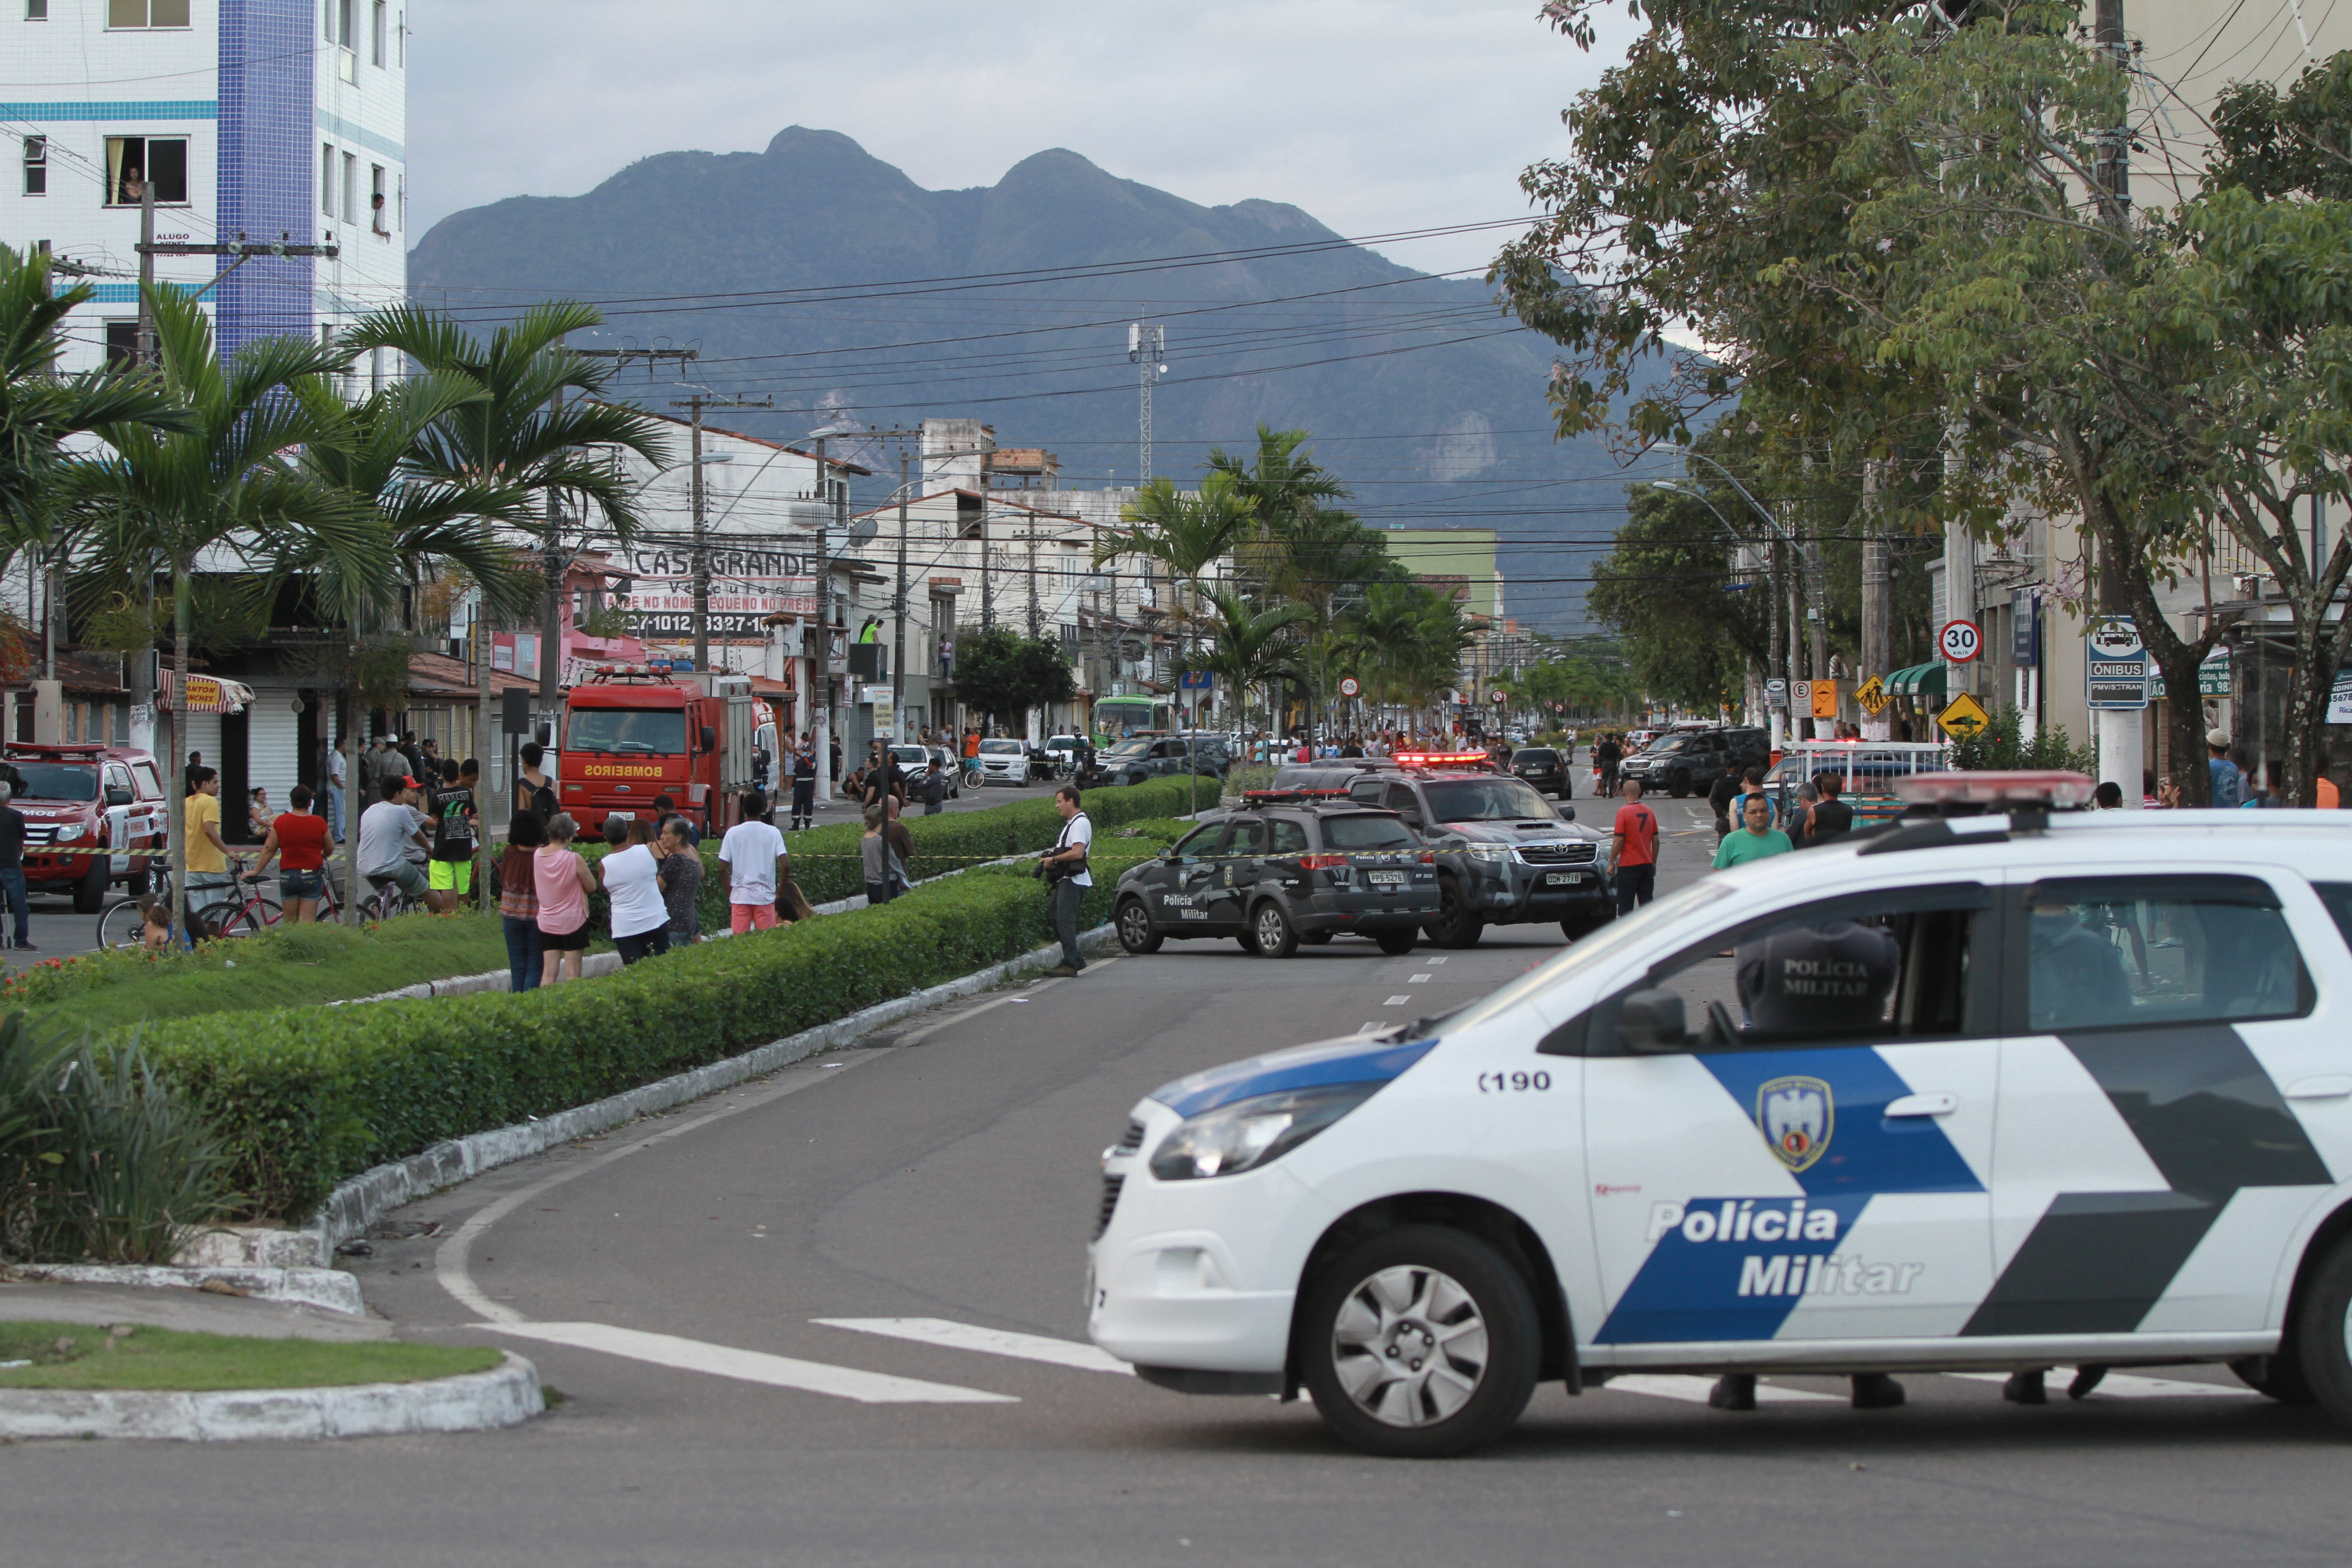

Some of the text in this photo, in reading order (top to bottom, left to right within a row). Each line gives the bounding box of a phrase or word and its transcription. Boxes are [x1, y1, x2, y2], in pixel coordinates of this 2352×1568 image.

[636, 550, 817, 576] CAS GRANDE
[644, 596, 659, 608] NO
[664, 596, 695, 609] NOME
[709, 597, 757, 611] EQUENO
[762, 598, 776, 610] NO
[780, 598, 817, 612] PREÇO
[1947, 629, 1975, 648] 30
[2093, 662, 2141, 675] ÔNIBUS
[2199, 671, 2217, 681] cintos,
[1798, 685, 1804, 695] E
[2200, 681, 2212, 693] ria
[438, 793, 469, 804] MARESIA
[1637, 813, 1648, 833] 7
[1164, 894, 1192, 906] Polícia
[1181, 909, 1208, 919] Militar
[1784, 958, 1868, 978] POLÍCIA
[1783, 979, 1868, 997] MILITAR
[1646, 1199, 1838, 1244] Polícia
[1737, 1252, 1925, 1297] Militar
